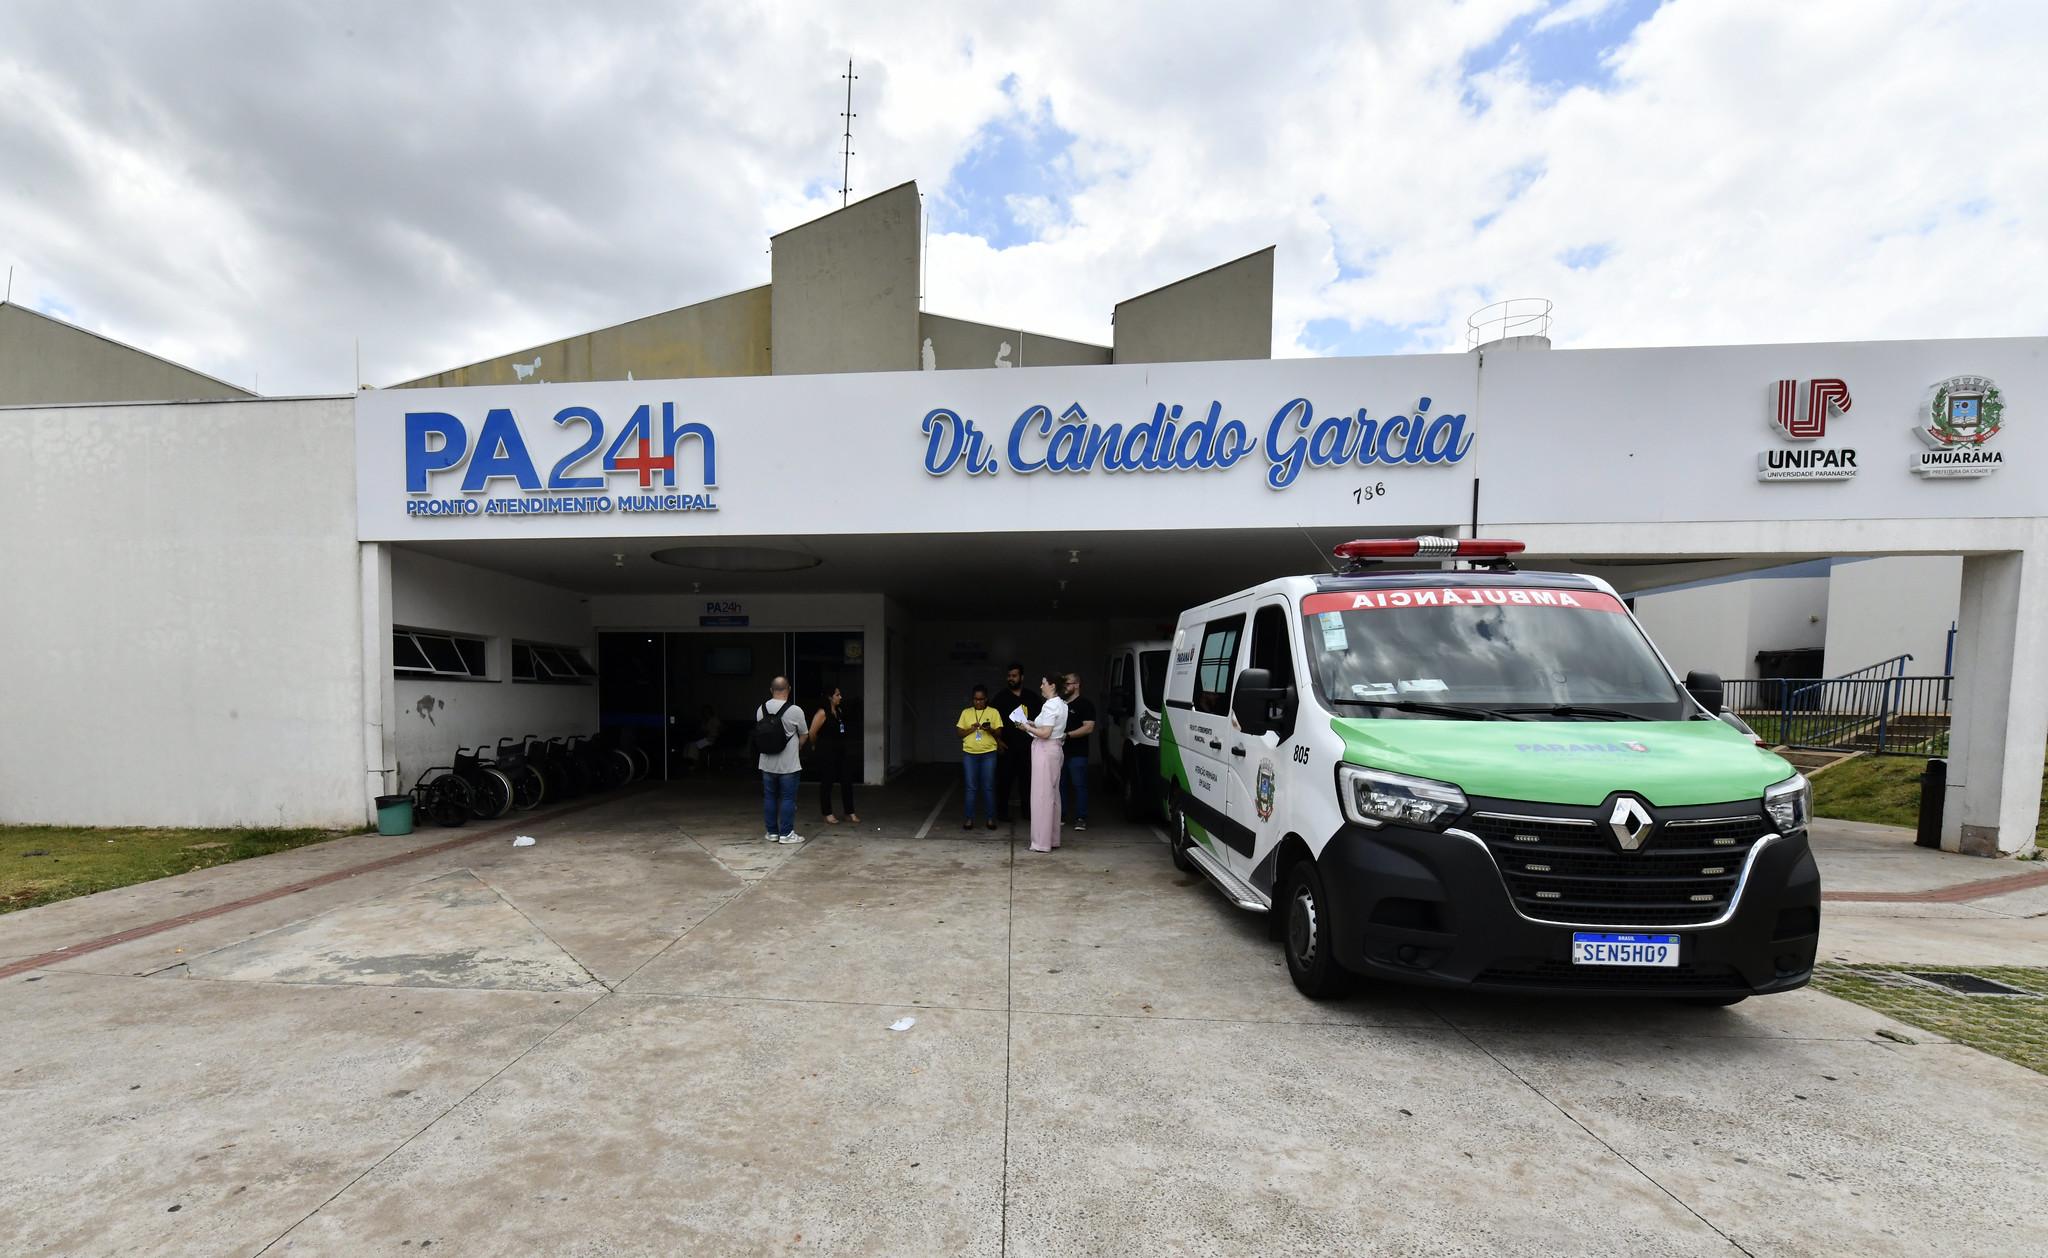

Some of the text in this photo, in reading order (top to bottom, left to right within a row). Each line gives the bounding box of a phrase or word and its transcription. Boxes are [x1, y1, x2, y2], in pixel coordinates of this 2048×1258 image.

[921, 397, 1474, 489] Dr. Cândido Garcia
[1768, 449, 1857, 469] UNIPAR
[1921, 452, 2003, 464] UMUARAMA
[1353, 481, 1386, 505] 786
[406, 494, 716, 515] PRONTO ATENDIMENTO MUNICIPAL
[1293, 744, 1311, 766] 805
[1583, 944, 1668, 963] SEN5H09
